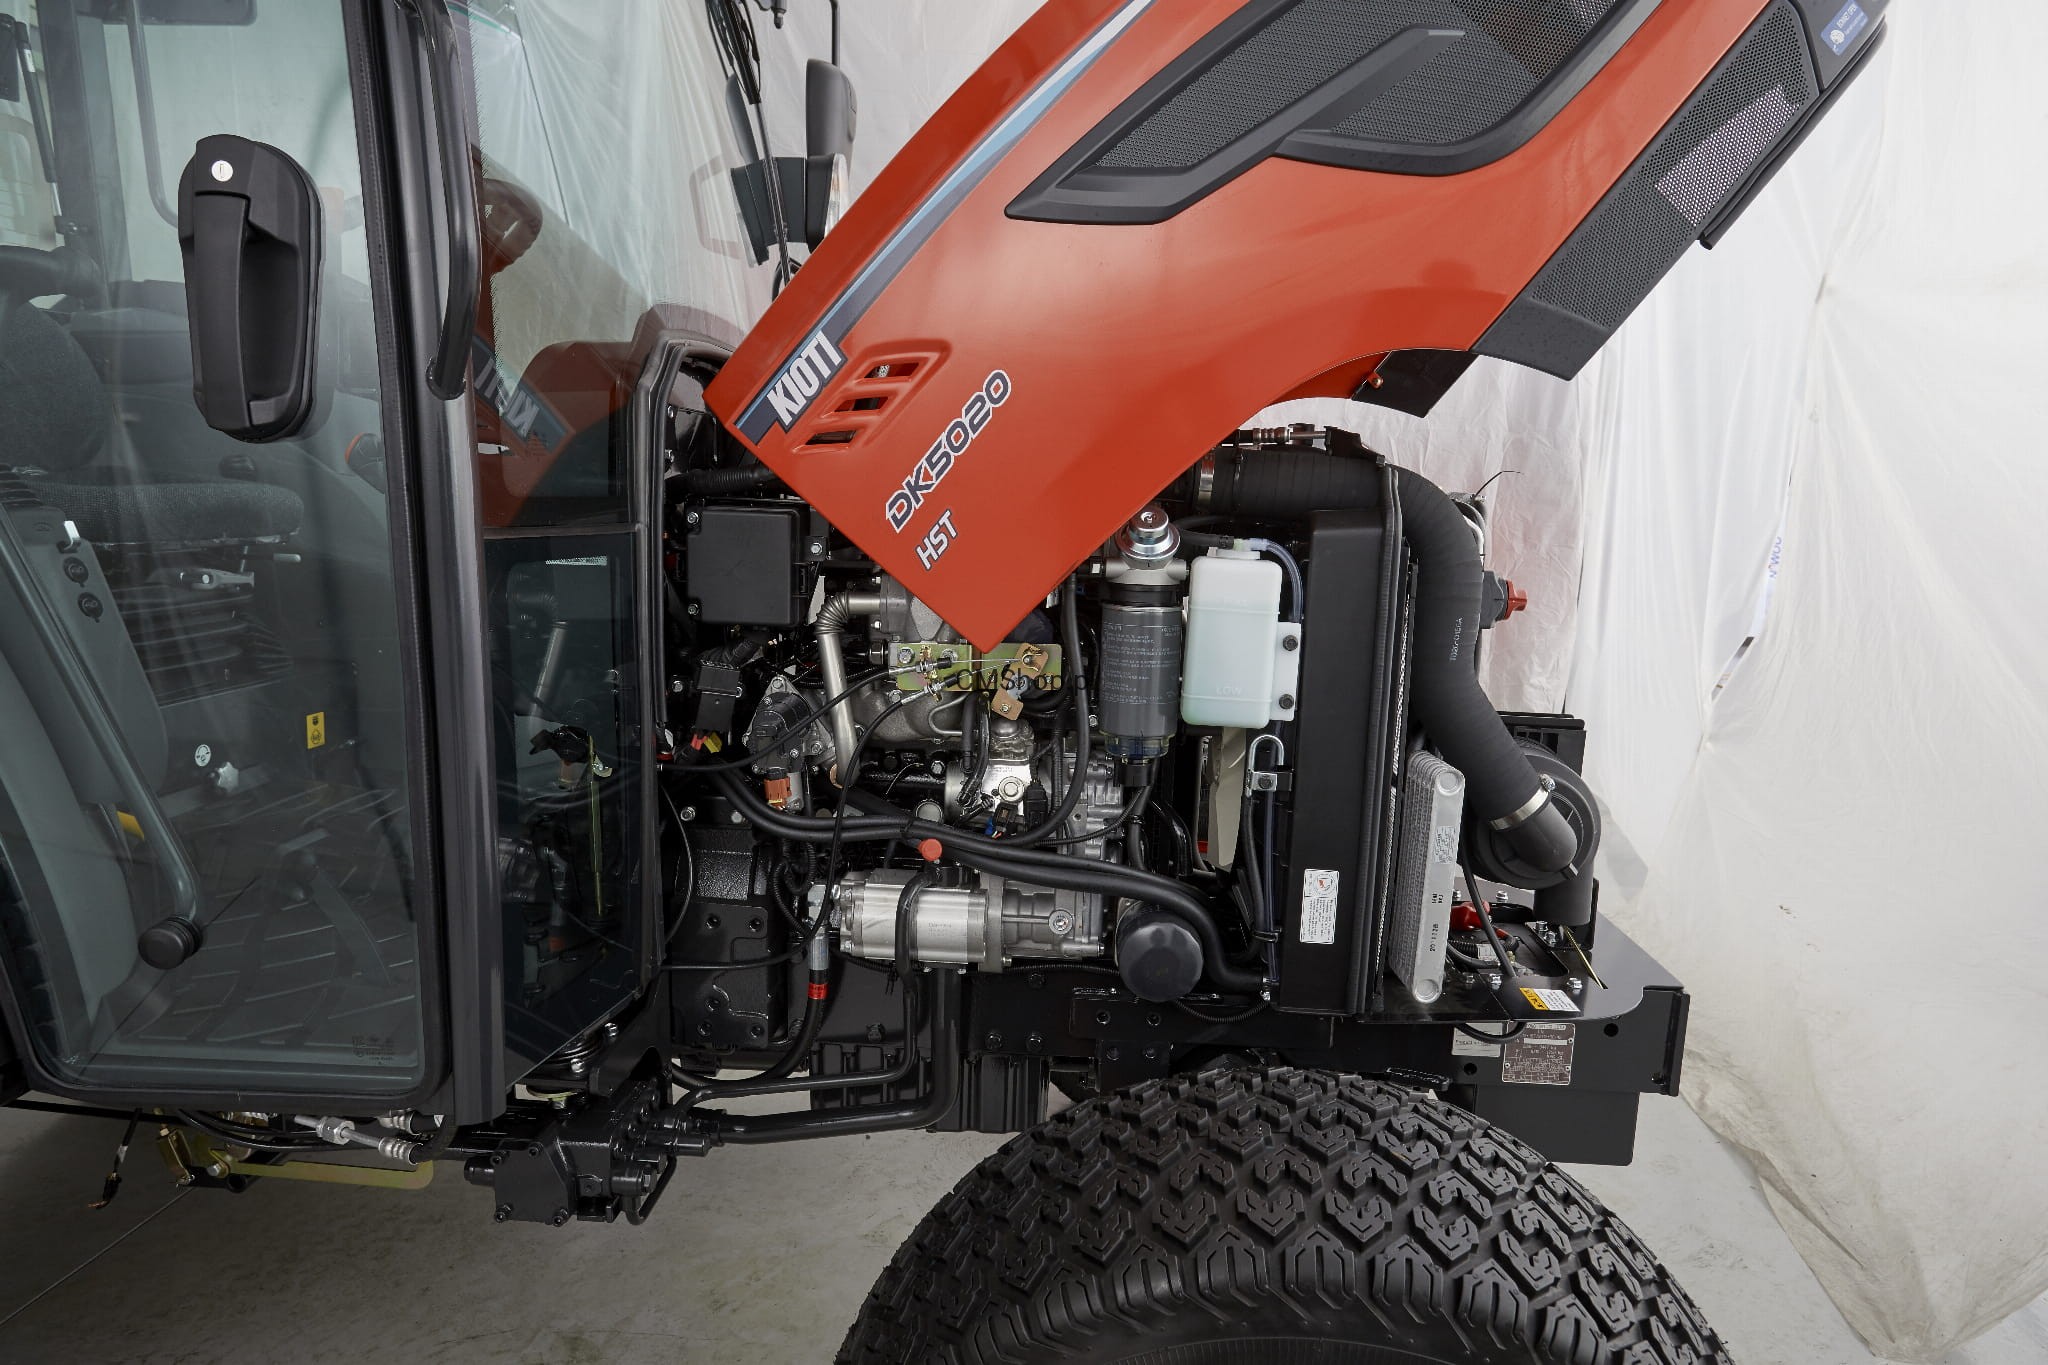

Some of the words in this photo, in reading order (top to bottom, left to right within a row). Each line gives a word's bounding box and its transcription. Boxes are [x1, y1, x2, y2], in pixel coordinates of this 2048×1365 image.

[767, 329, 842, 427] KIOTI
[886, 369, 1012, 534] DK5020
[915, 509, 959, 571] HST
